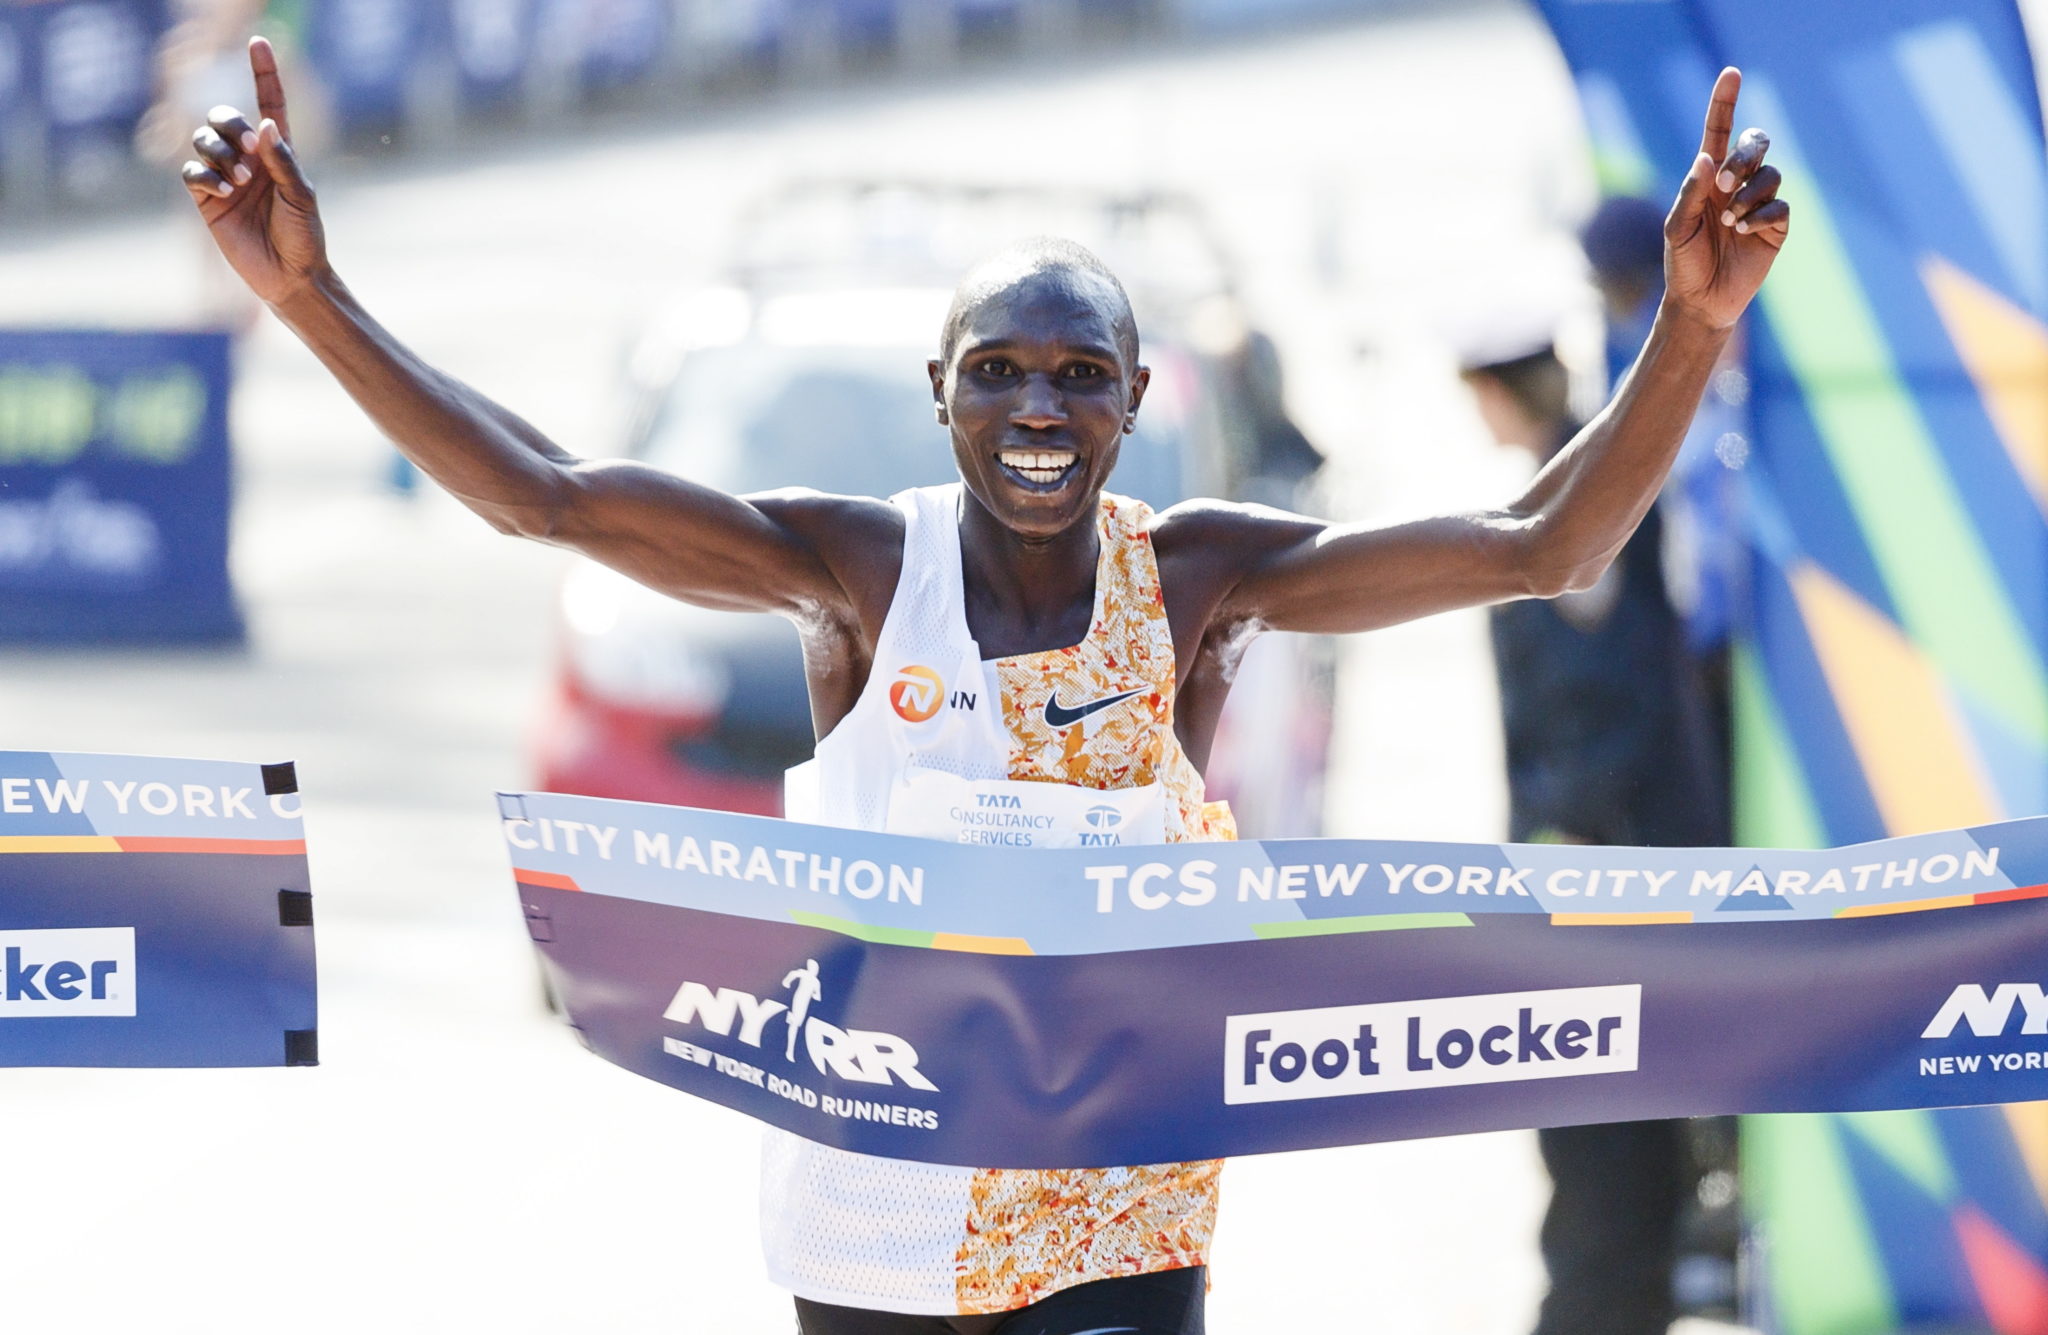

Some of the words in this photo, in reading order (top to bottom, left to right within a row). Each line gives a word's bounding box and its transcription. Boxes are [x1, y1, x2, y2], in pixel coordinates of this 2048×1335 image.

[102, 780, 257, 819] YORK
[976, 794, 1021, 809] TATA
[504, 818, 619, 861] CITY
[634, 832, 924, 906] MARATHON
[961, 829, 1032, 847] SERVICES
[1084, 860, 1217, 913] TCS
[1237, 863, 1369, 902] NEW
[1380, 864, 1536, 897] YORK
[1545, 868, 1677, 898] CITY
[1689, 847, 2000, 897] MARATHON
[0, 947, 117, 1001] ker
[1243, 1024, 1380, 1086] Foot
[1407, 1007, 1622, 1072] Locker
[1919, 1055, 1982, 1076] NEW
[664, 1036, 713, 1068] NEW
[713, 1052, 765, 1088] YORK
[767, 1073, 818, 1108] ROAD
[822, 1095, 939, 1130] RUNNERS
